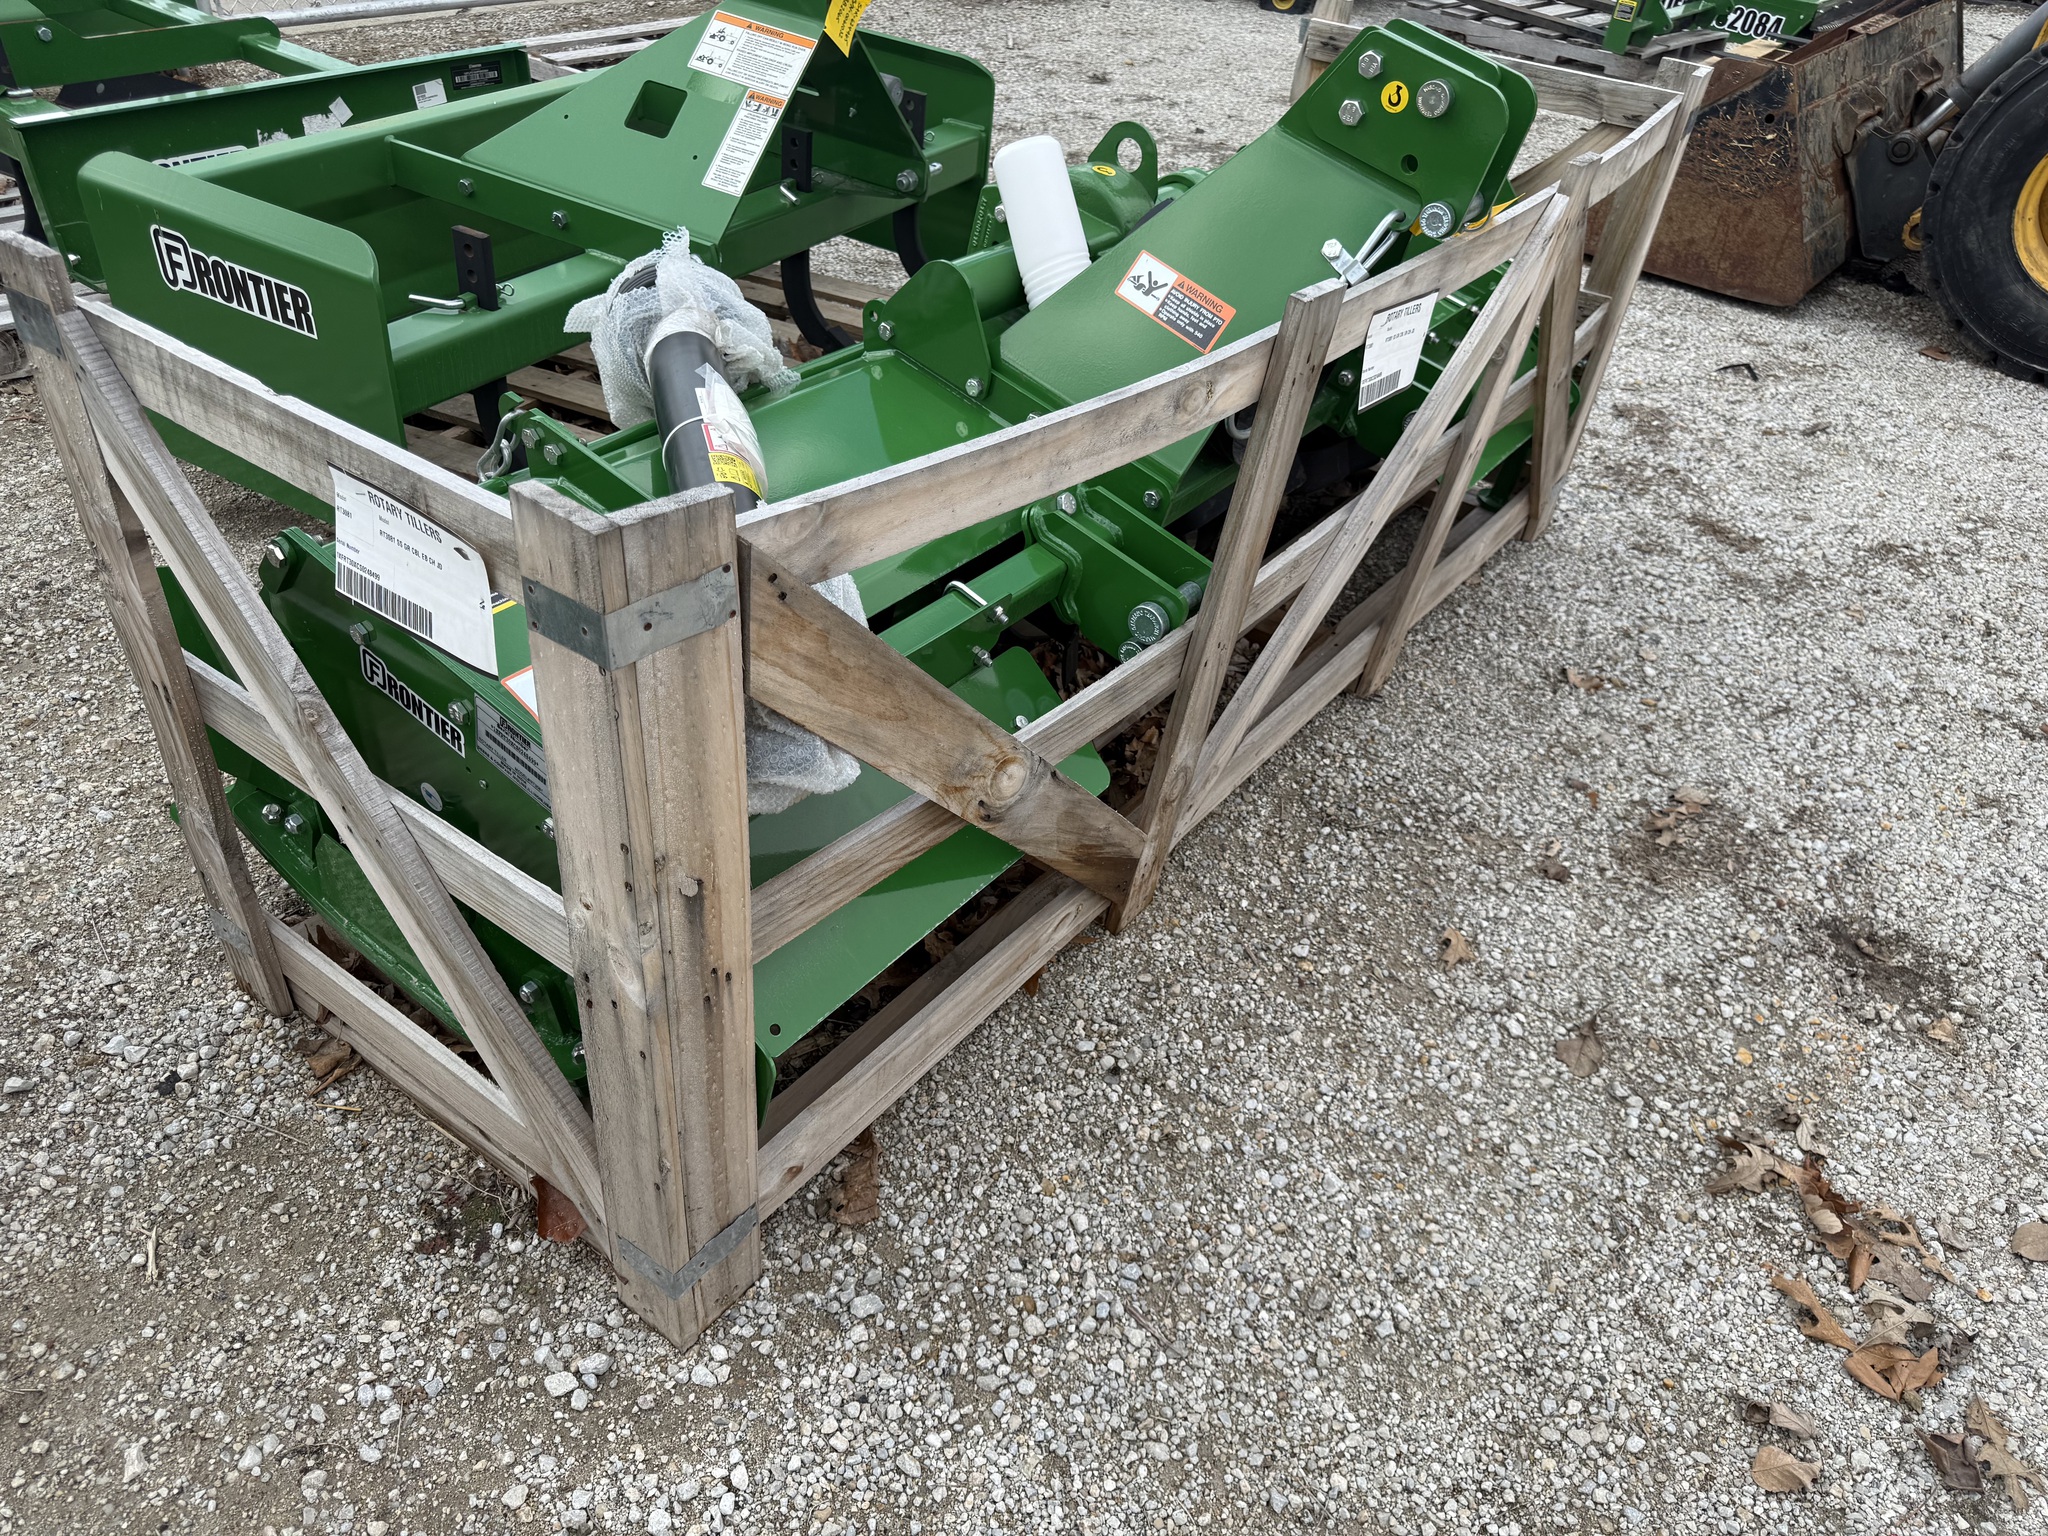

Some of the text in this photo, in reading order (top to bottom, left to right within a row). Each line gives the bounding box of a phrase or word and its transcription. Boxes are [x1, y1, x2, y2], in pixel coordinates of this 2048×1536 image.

[755, 25, 784, 39] WARNING
[1714, 6, 1784, 37] 2084
[755, 95, 782, 107] WARNING
[152, 227, 316, 336] FRONTIER
[1184, 297, 1199, 310] INJURY
[1200, 308, 1213, 319] FROM
[1213, 316, 1223, 325] PTO
[1185, 284, 1224, 313] WARNING
[367, 490, 443, 544] ROTARY TILLERS
[362, 648, 463, 754] FRONTIER
[499, 715, 531, 749] FRONTIER
